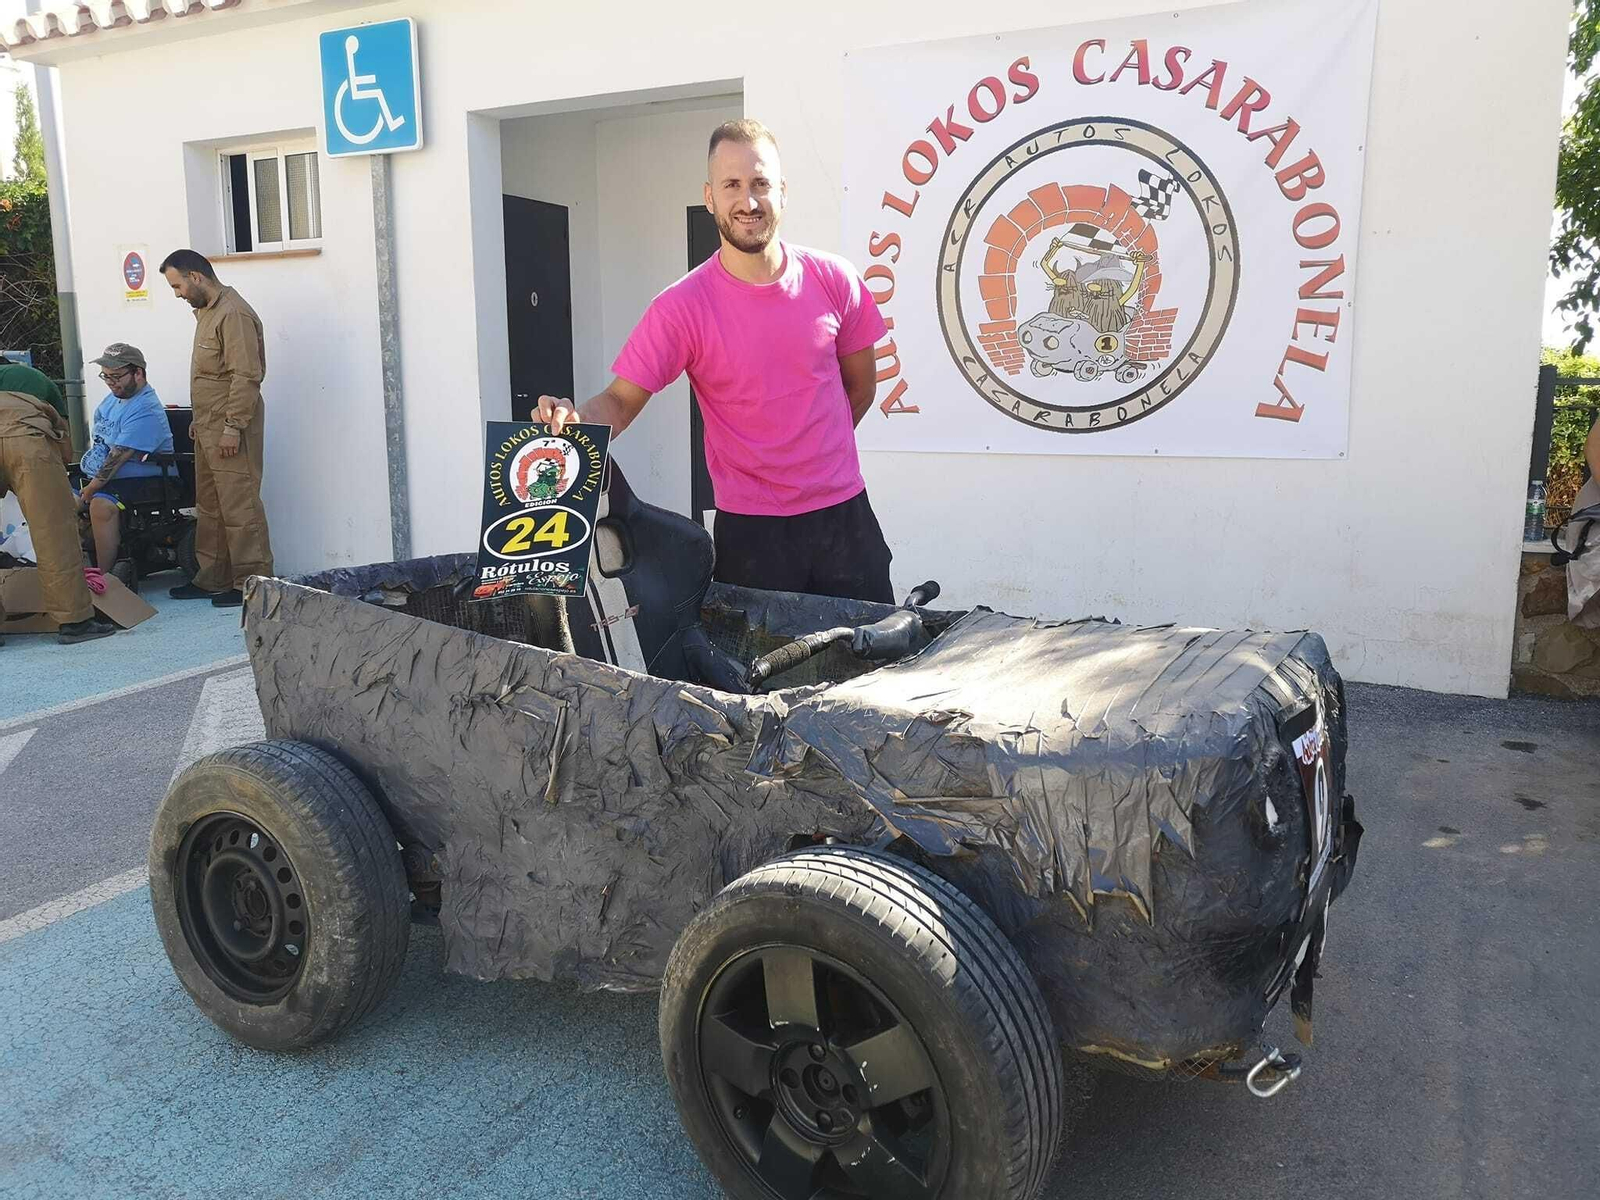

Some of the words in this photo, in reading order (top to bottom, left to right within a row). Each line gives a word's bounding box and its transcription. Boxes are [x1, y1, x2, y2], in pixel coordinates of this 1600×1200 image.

[881, 55, 1040, 220] LOKOS
[943, 203, 976, 273] ACR
[1005, 124, 1132, 168] AUTOS
[1165, 147, 1233, 263] LOKOS
[1072, 38, 1346, 424] CASARABONELA
[863, 231, 920, 419] AUOS
[1101, 336, 1112, 350] 1
[962, 351, 1206, 428] CASARABONELA
[494, 424, 540, 461] LOKOS
[544, 424, 602, 502] CSARABONELA
[489, 462, 511, 507] AUTOS
[525, 498, 557, 508] EDICION
[501, 511, 569, 554] 24
[480, 558, 570, 579] Rótulos
